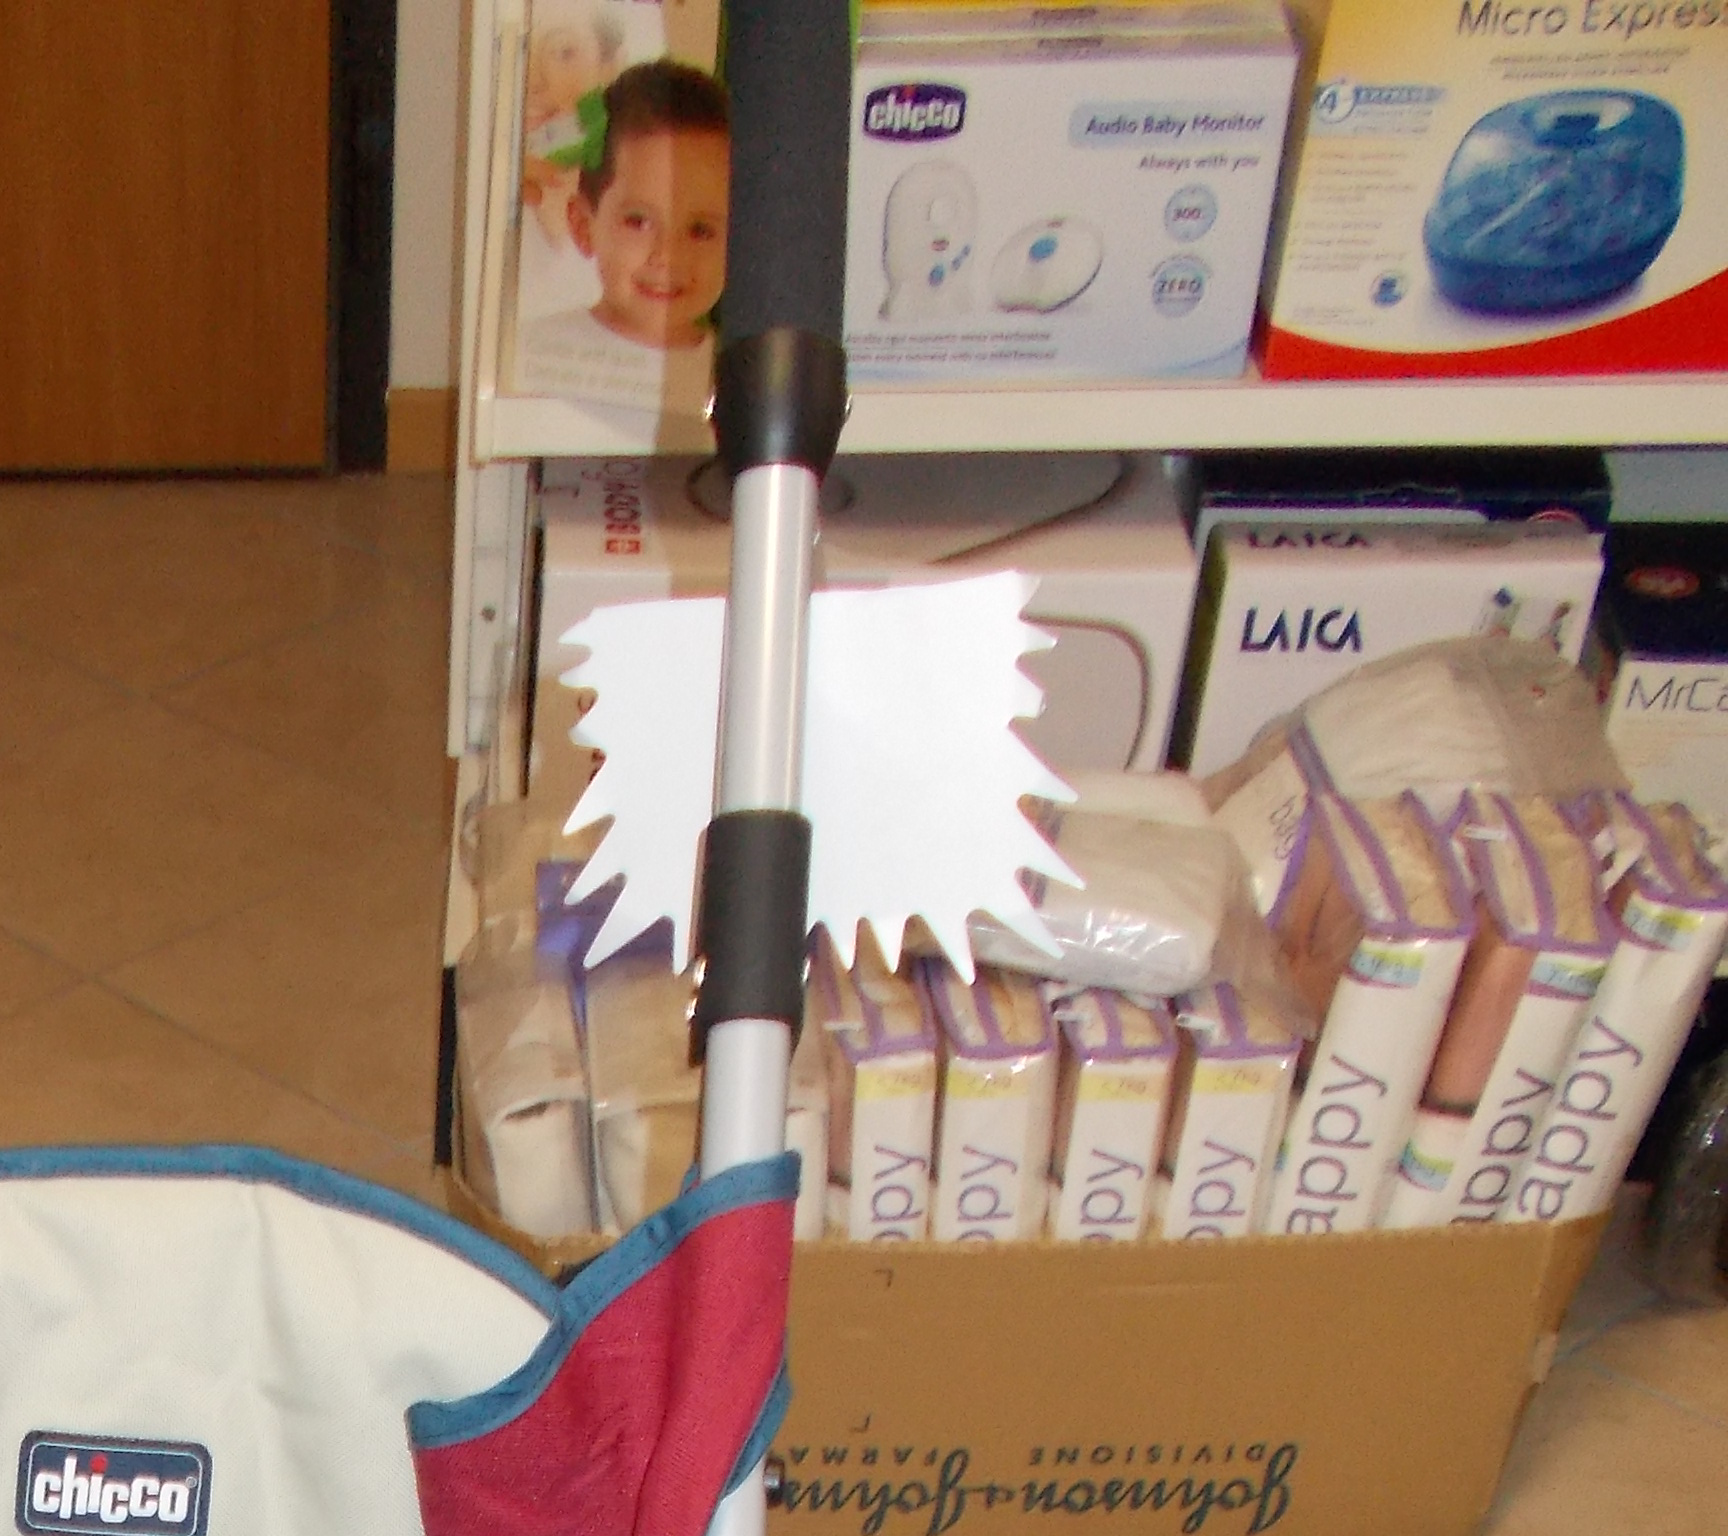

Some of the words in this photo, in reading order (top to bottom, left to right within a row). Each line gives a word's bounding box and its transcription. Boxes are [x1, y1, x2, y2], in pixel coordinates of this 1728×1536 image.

[1456, 0, 1569, 36] Micro
[868, 84, 960, 132] chicco
[1085, 115, 1138, 135] Audio
[1141, 114, 1187, 138] Baby
[1192, 112, 1265, 132] Monitor
[1138, 153, 1191, 173] Always
[1194, 155, 1227, 169] with
[1231, 155, 1260, 172] you
[1157, 278, 1202, 294] ZERO
[1239, 606, 1363, 652] LAICA
[790, 1445, 958, 1467] FARMA
[1029, 1443, 1266, 1466] DIVISIONE
[32, 1454, 191, 1524] chicco
